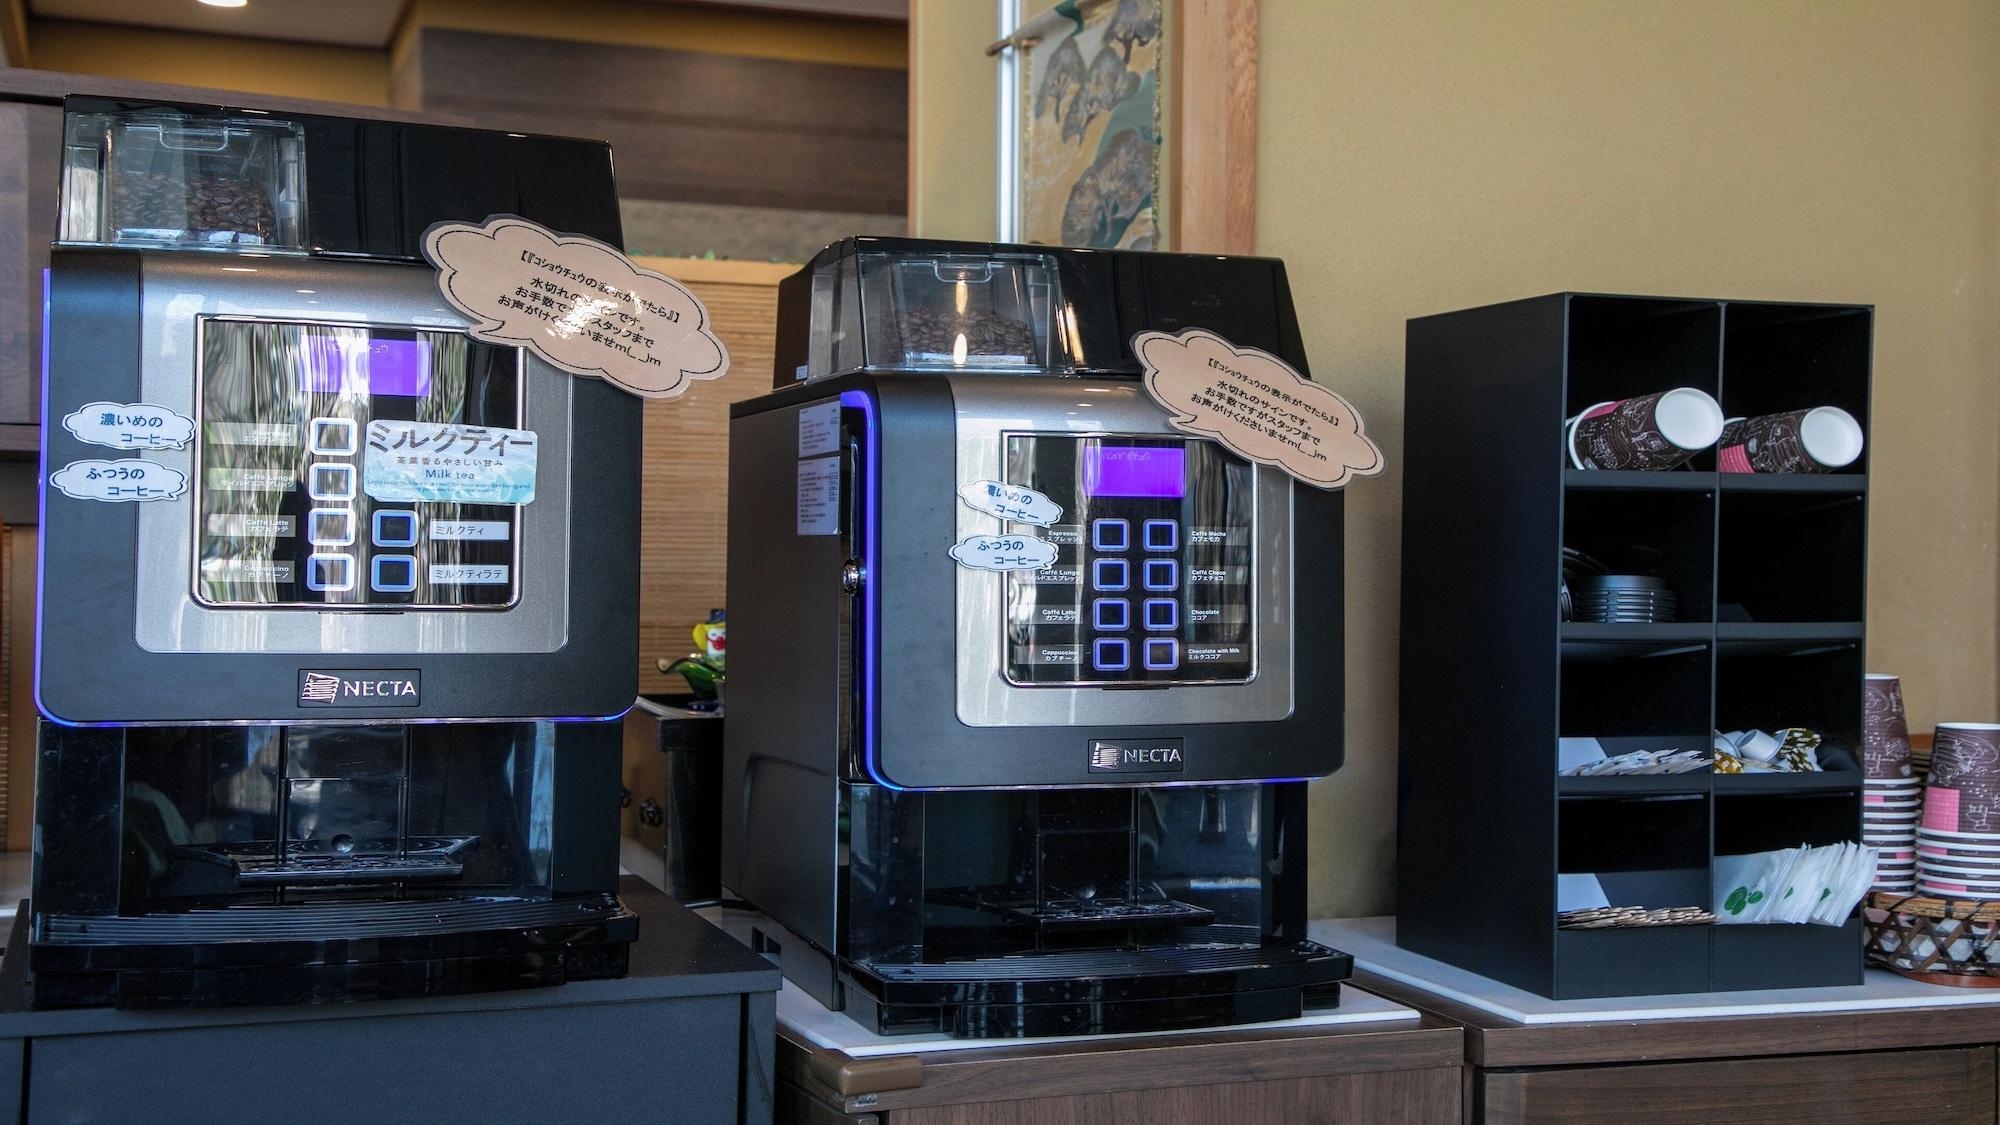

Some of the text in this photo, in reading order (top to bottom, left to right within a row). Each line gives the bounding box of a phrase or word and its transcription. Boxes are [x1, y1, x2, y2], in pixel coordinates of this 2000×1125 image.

[530, 277, 645, 331] 水切れのンです。
[515, 286, 655, 348] お手数でスタッフまで
[1216, 380, 1312, 430] 水切れのサインです。
[100, 413, 163, 427] 濃いめの
[1205, 387, 1321, 445] お手数ですがスタッフまで
[121, 433, 177, 444] コーヒー
[369, 423, 533, 456] ミルクティー
[86, 467, 145, 479] ふつうの
[425, 469, 475, 480] Milk tea
[107, 486, 164, 496] コーヒー
[995, 504, 1039, 519] コーヒー
[436, 525, 484, 535] ミルクティ
[978, 540, 1024, 551] ふつうの
[994, 556, 1039, 565] コーヒー
[435, 569, 502, 579] ミルクティラテ
[343, 680, 416, 697] NECTA
[1124, 748, 1182, 763] NECTA
